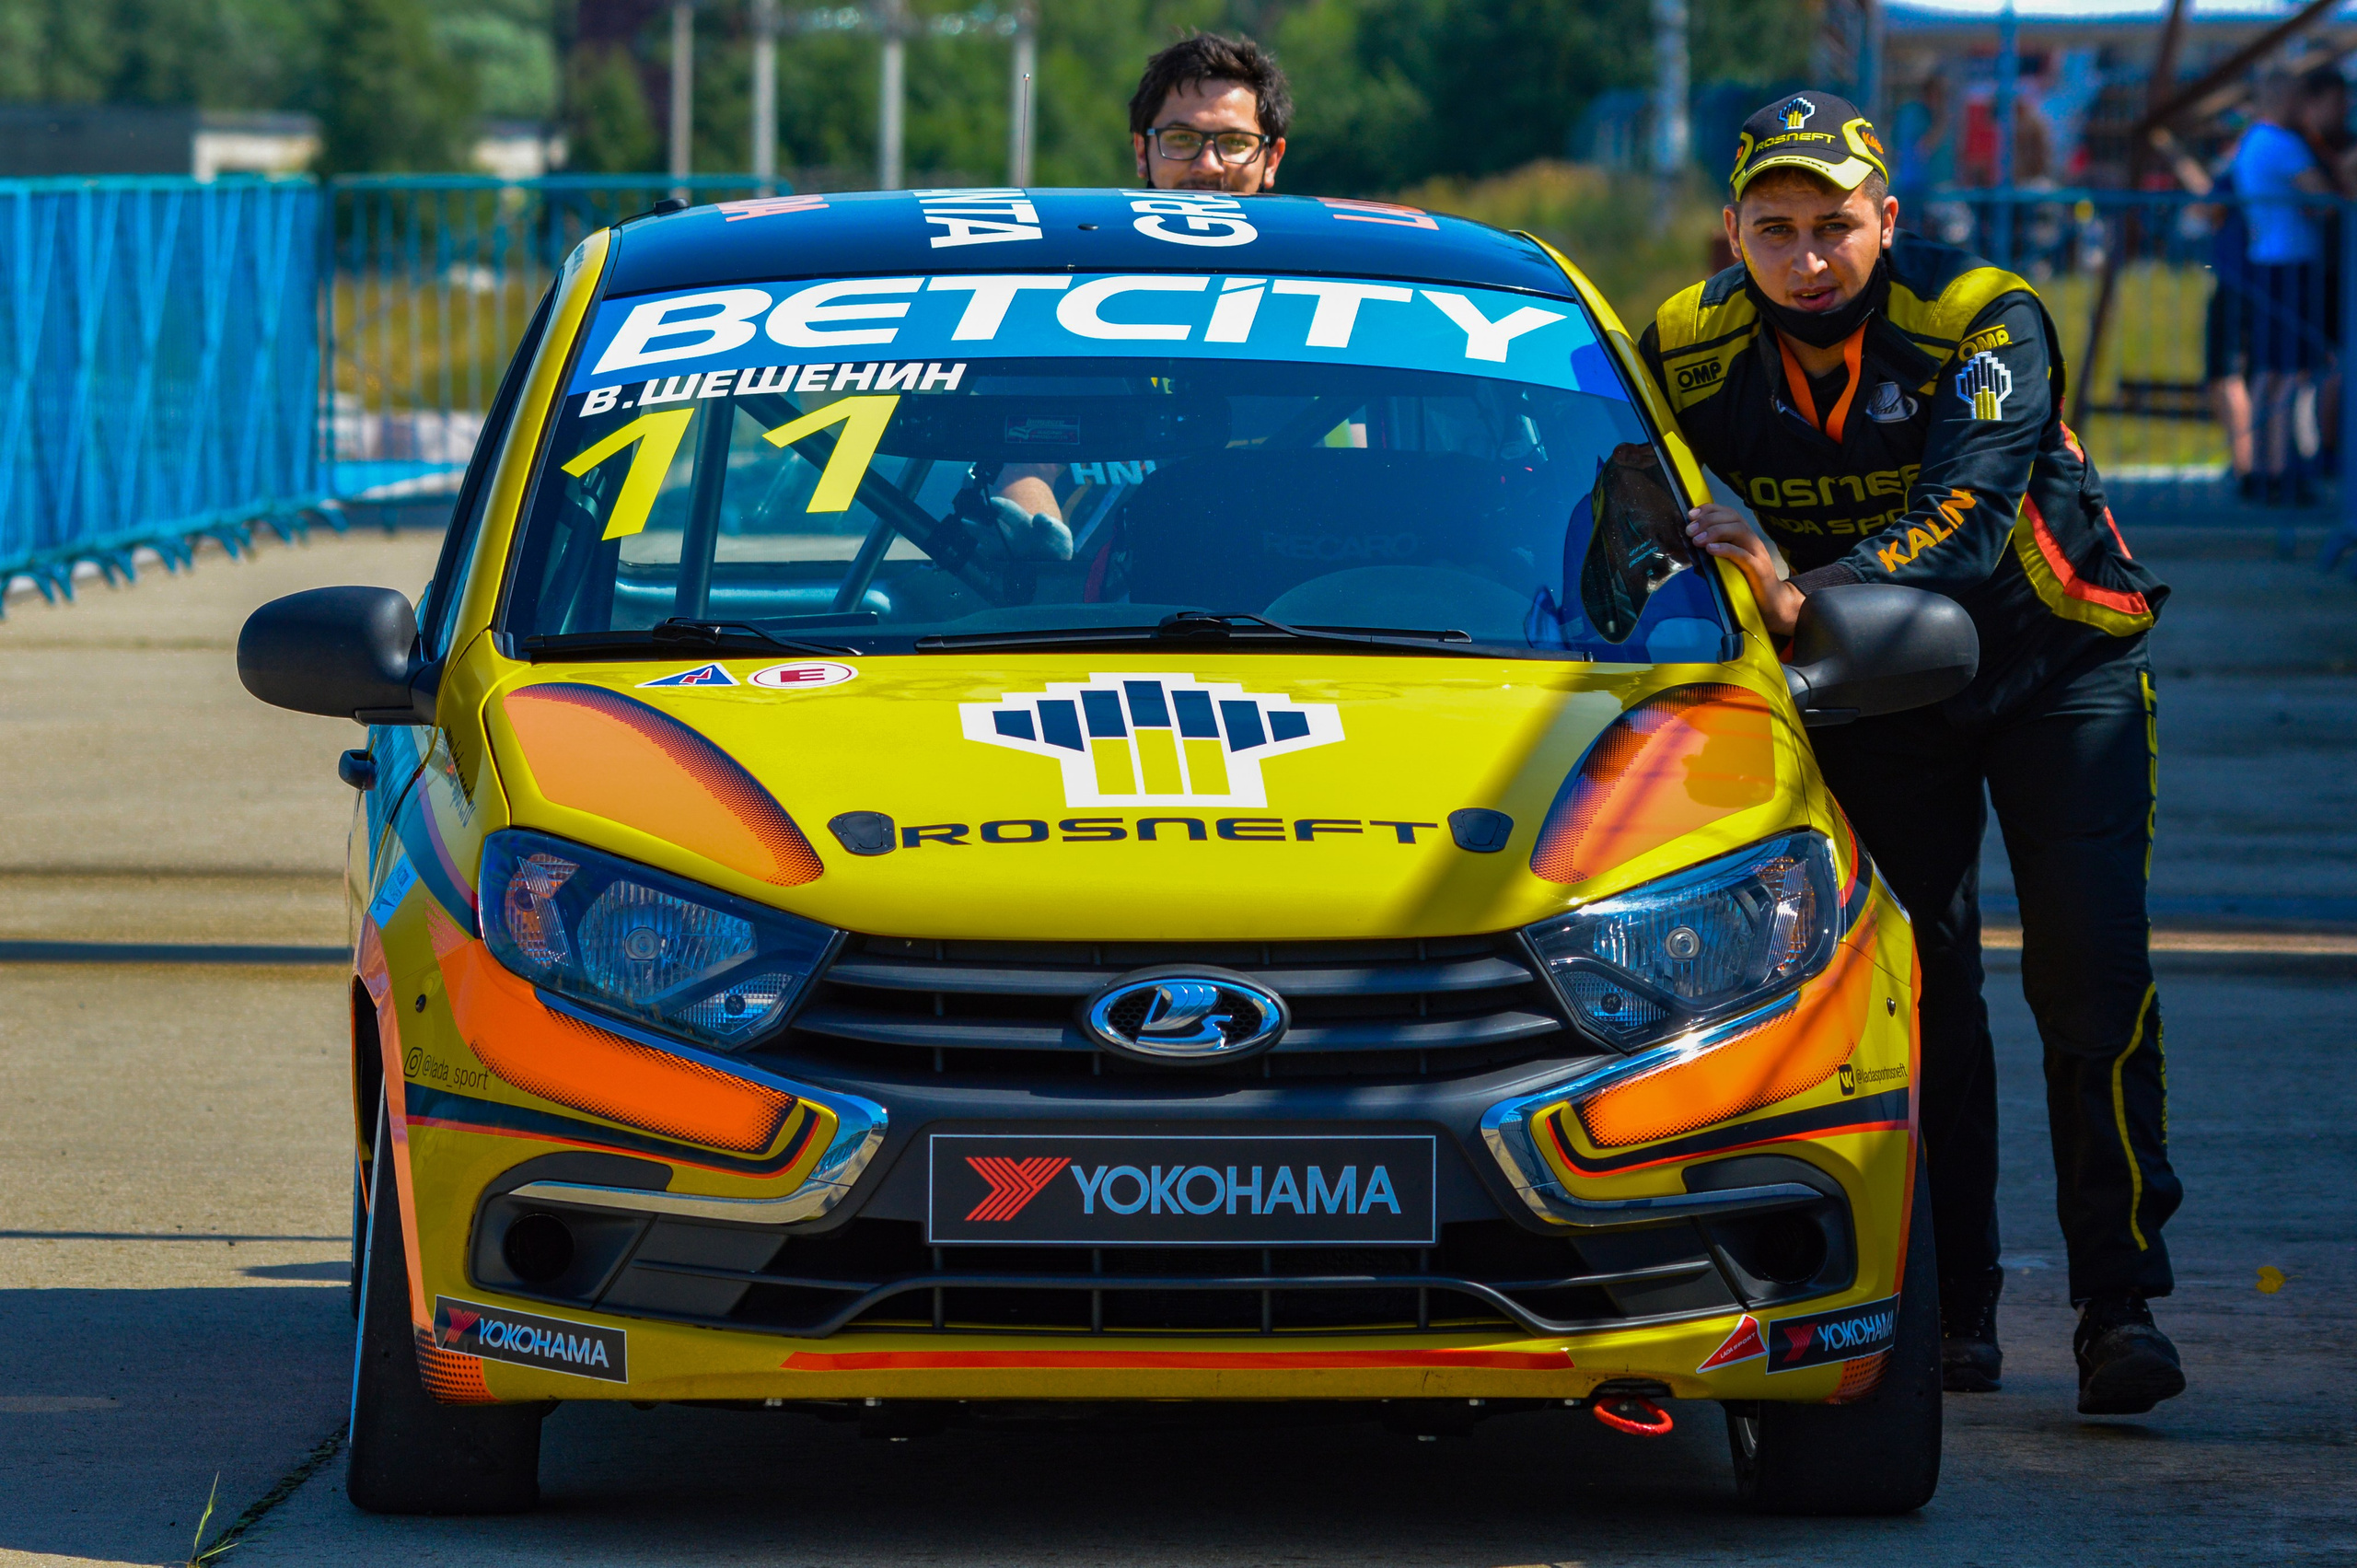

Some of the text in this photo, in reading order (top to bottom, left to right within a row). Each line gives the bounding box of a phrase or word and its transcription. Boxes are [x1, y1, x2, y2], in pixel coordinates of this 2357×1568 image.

[1755, 132, 1837, 153] ROSNEFT
[591, 274, 1568, 376] BETCITY
[1958, 329, 2010, 362] OMP
[578, 363, 967, 418] В.ШЕШЕНИН
[1678, 361, 1722, 388] OMP
[1877, 488, 1977, 573] KALIN
[901, 816, 1439, 847] ROSNEFT
[422, 1054, 489, 1090] @lada_sport
[1070, 1165, 1402, 1214] YOKOHAMA
[479, 1317, 610, 1368] YOKOHAMA
[1720, 1331, 1757, 1360] LADA SPORT
